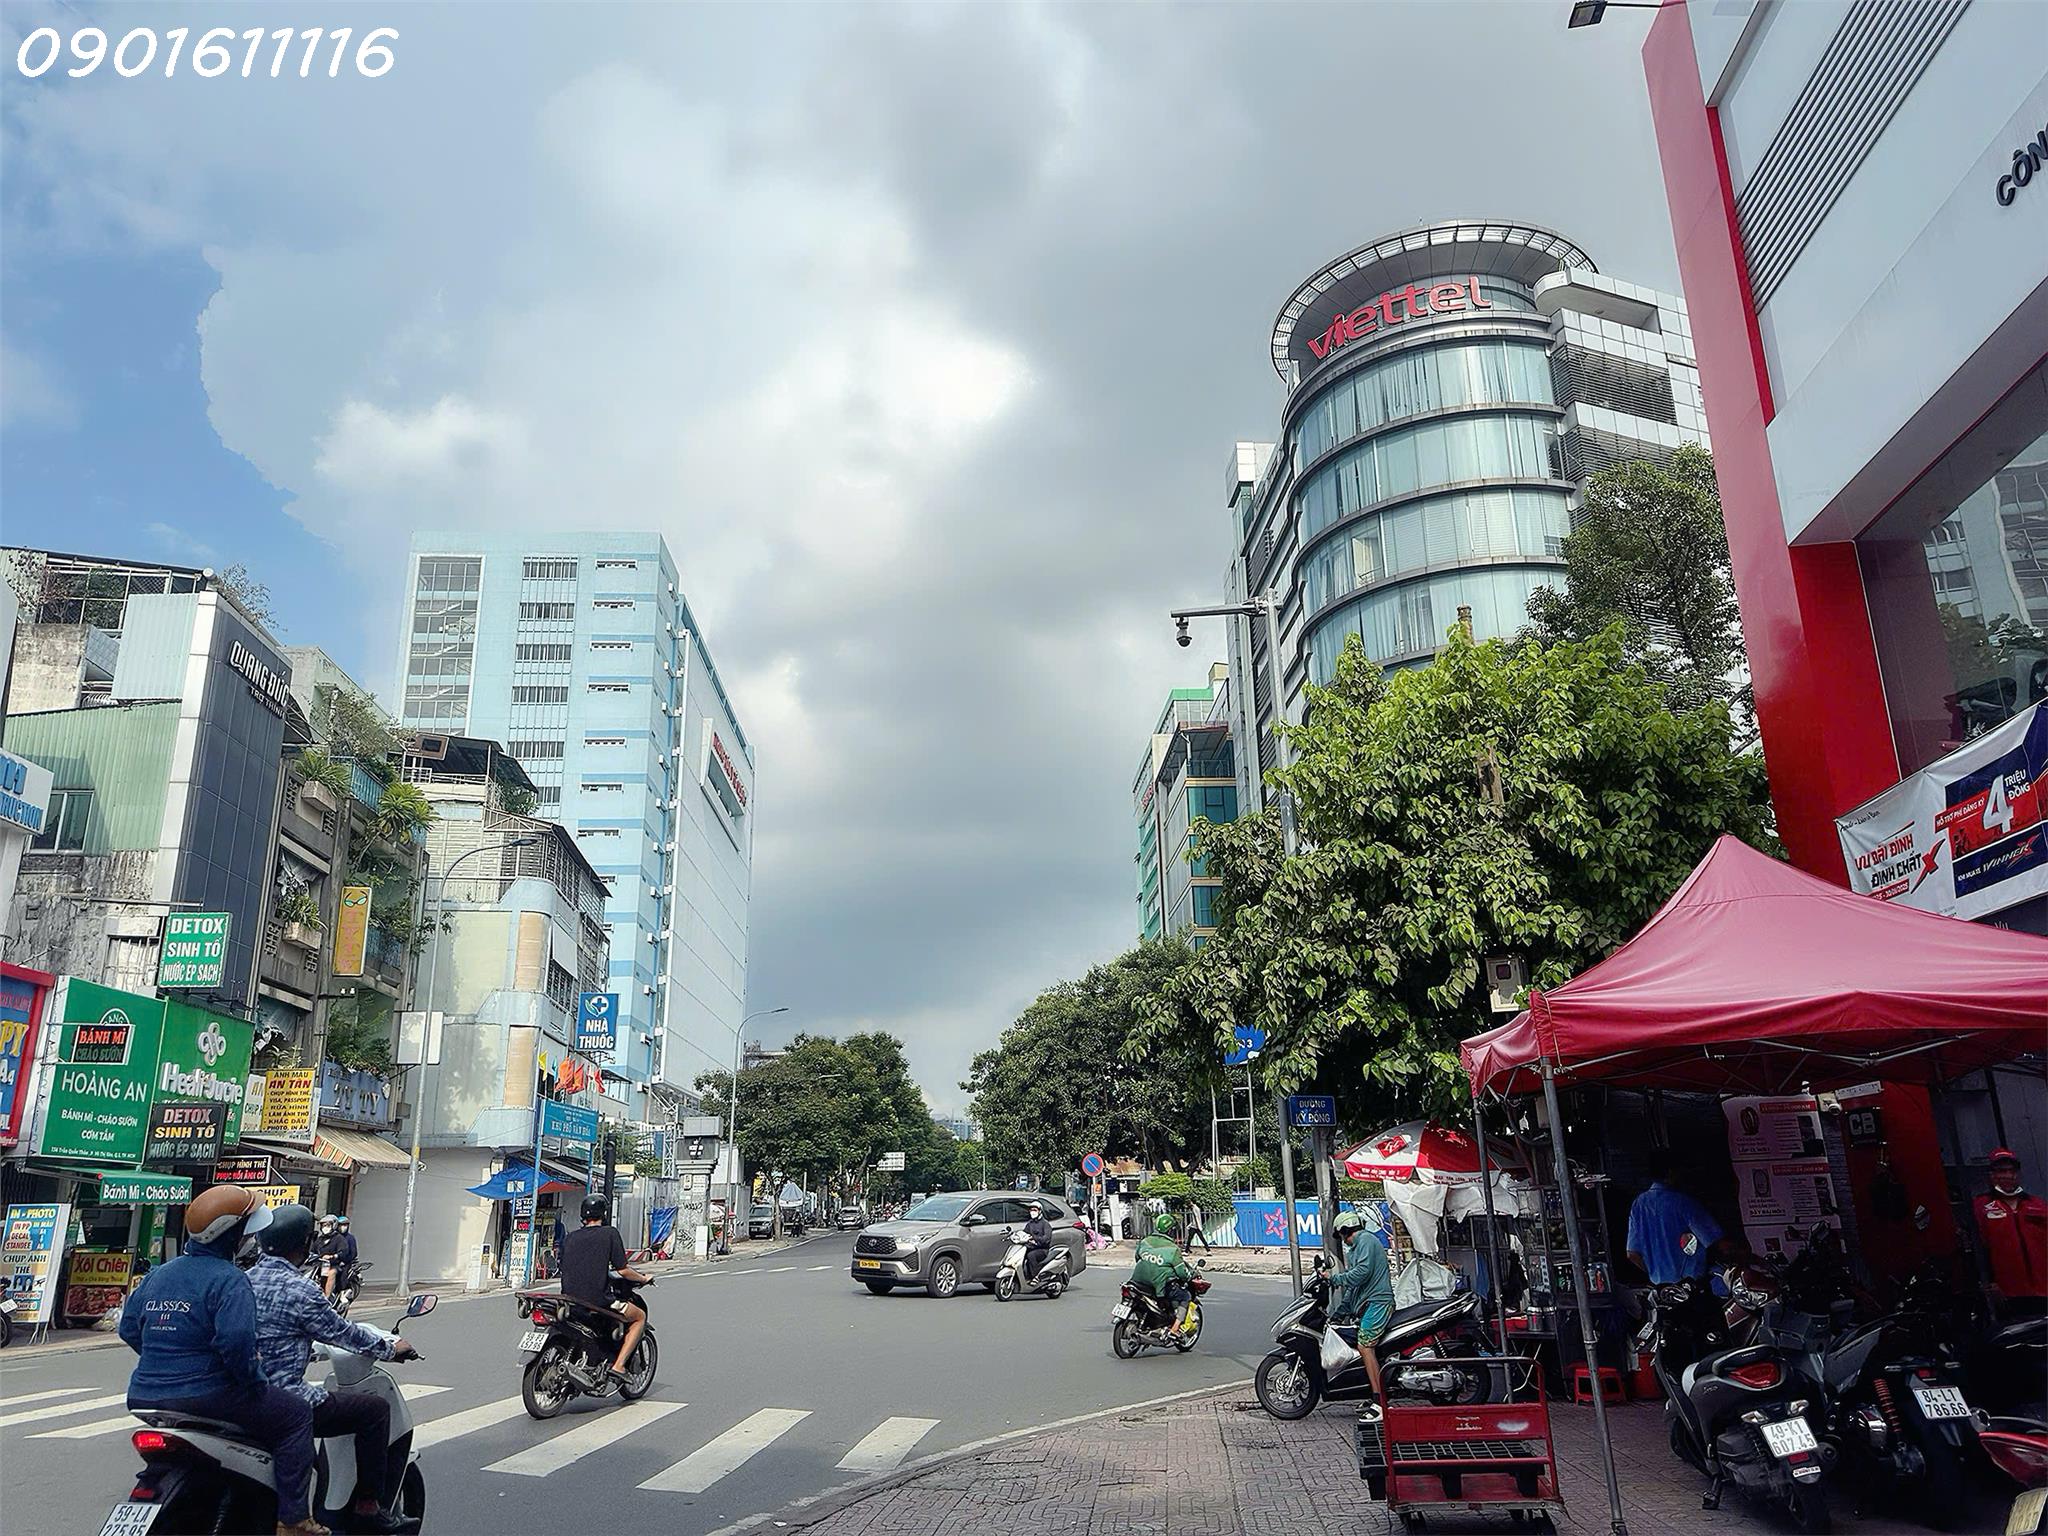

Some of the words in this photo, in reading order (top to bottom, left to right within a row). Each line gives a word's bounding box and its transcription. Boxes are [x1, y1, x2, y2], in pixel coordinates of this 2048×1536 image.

[1306, 275, 1491, 360] viettel
[230, 641, 268, 690] QUANG
[267, 671, 290, 707] ĐỨC
[1983, 774, 2014, 833] 4
[2005, 769, 2026, 787] TRIỆU
[170, 918, 225, 934] DETOX
[167, 942, 201, 958] SINH
[204, 936, 222, 958] TỐ
[185, 961, 197, 982] ÉP
[586, 1018, 608, 1032] NHÀ
[79, 1028, 109, 1045] BÁNH
[579, 1033, 614, 1048] THUỐC
[62, 1070, 121, 1099] HOÀNG
[123, 1081, 147, 1103] AN
[62, 1108, 84, 1121] BÁNH
[163, 1108, 212, 1123] DETOX
[154, 1126, 192, 1139] SINH
[196, 1123, 217, 1139] TỐ
[103, 1184, 127, 1199] Bánh
[146, 1185, 168, 1200] Cháo
[28, 1209, 56, 1218] PHOTO
[1141, 1252, 1165, 1266] Grab
[145, 1300, 191, 1313] CLASSICS
[1922, 1389, 1957, 1403] 84-L1
[1925, 1402, 1967, 1417] 786.66
[1771, 1420, 1804, 1439] 49-K1
[1772, 1434, 1816, 1456] 607.45
[114, 1505, 153, 1523] 59-LA
